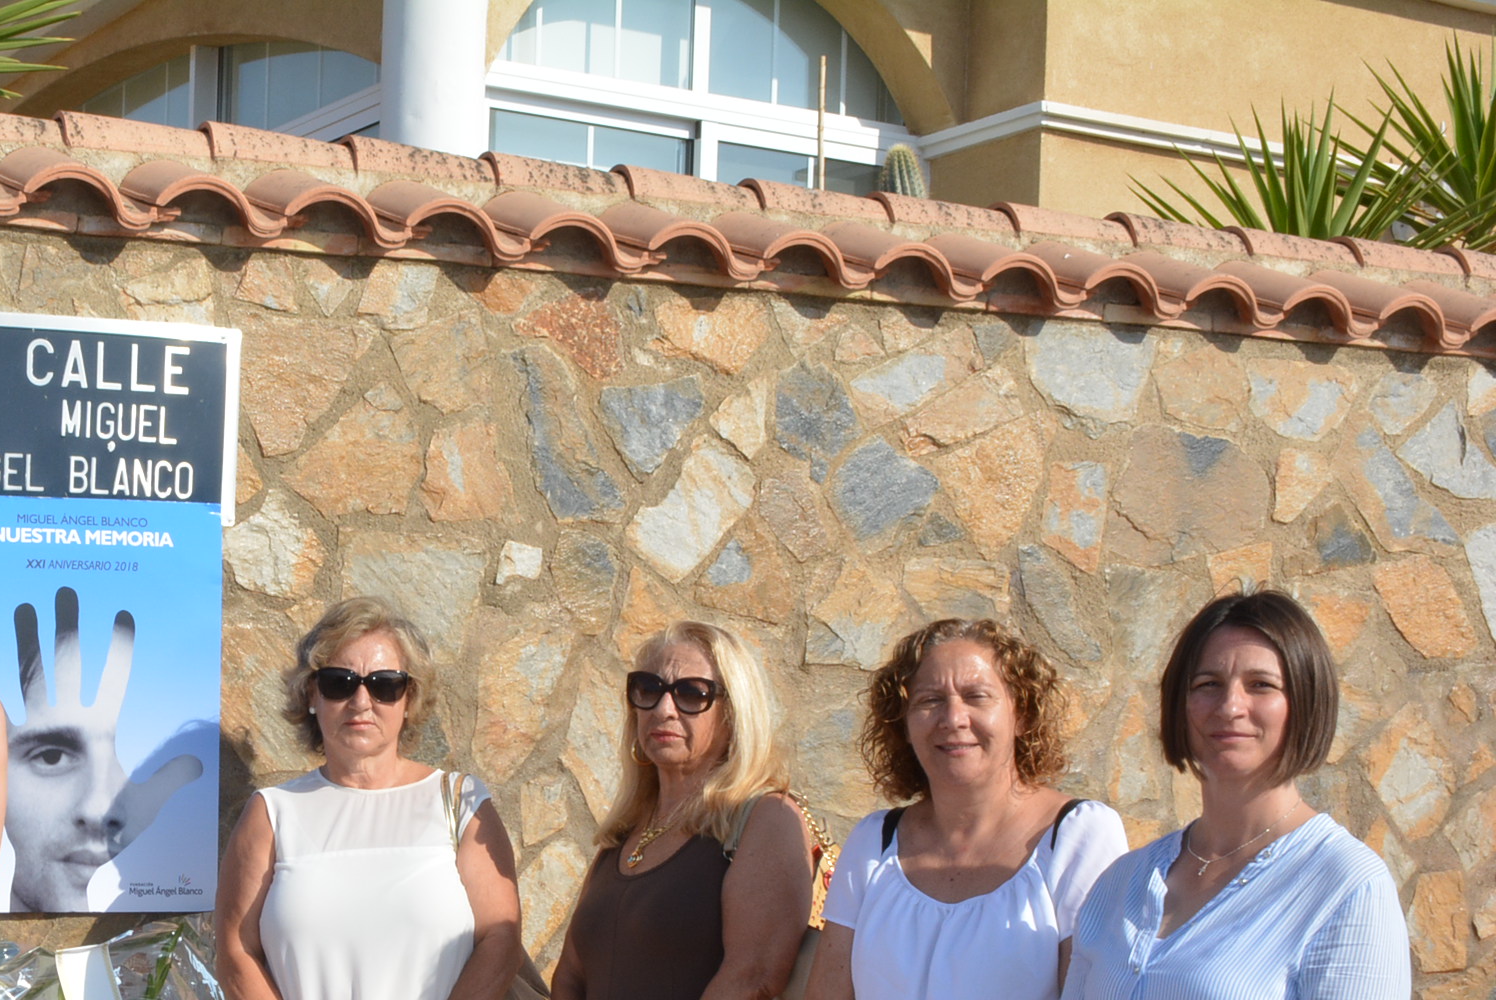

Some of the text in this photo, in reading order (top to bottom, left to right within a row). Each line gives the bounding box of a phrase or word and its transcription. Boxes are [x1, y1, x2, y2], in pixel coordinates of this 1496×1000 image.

[25, 337, 191, 395] CALLE
[60, 399, 178, 446] MIGUEL
[68, 455, 194, 500] BLANCO
[16, 513, 148, 528] MIGUEL ÁNGEL BLANCO
[85, 531, 174, 548] MEMORIA
[25, 558, 139, 572] XXI ANIVERSARIO 2018
[129, 885, 203, 897] Miguel Ángel Blanco
